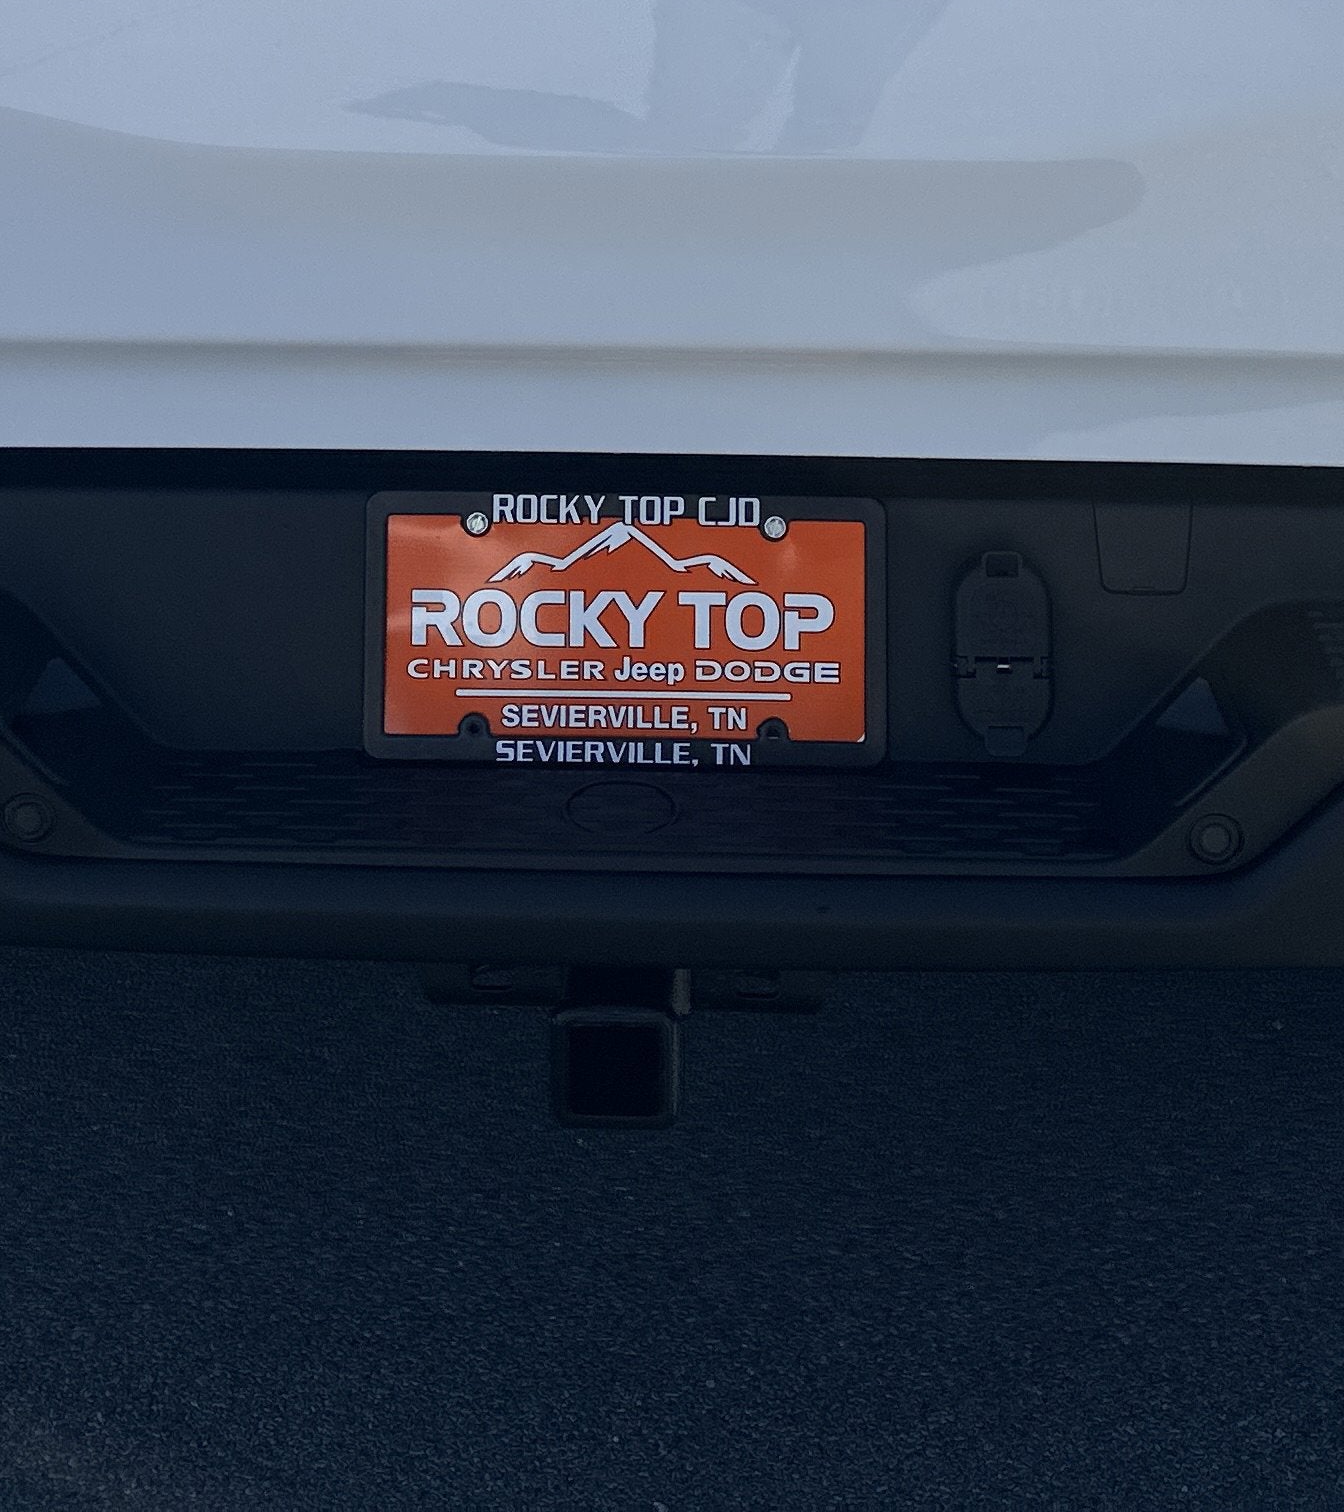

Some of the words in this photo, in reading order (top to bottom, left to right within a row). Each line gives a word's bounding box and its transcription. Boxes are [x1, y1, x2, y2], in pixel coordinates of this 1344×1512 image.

[492, 493, 607, 525] ROCKY
[618, 495, 685, 526] TOP
[698, 497, 760, 527] CJD
[410, 589, 665, 649] ROCKY
[678, 592, 835, 651] TOP
[406, 657, 604, 681] CHRYSLER
[613, 656, 686, 685] Jeep
[695, 661, 841, 684] DODGE
[501, 704, 698, 734] SEVIERVILLE,
[708, 707, 748, 731] TN
[496, 740, 699, 768] SEVIERVILLE,
[710, 742, 751, 766] TN
